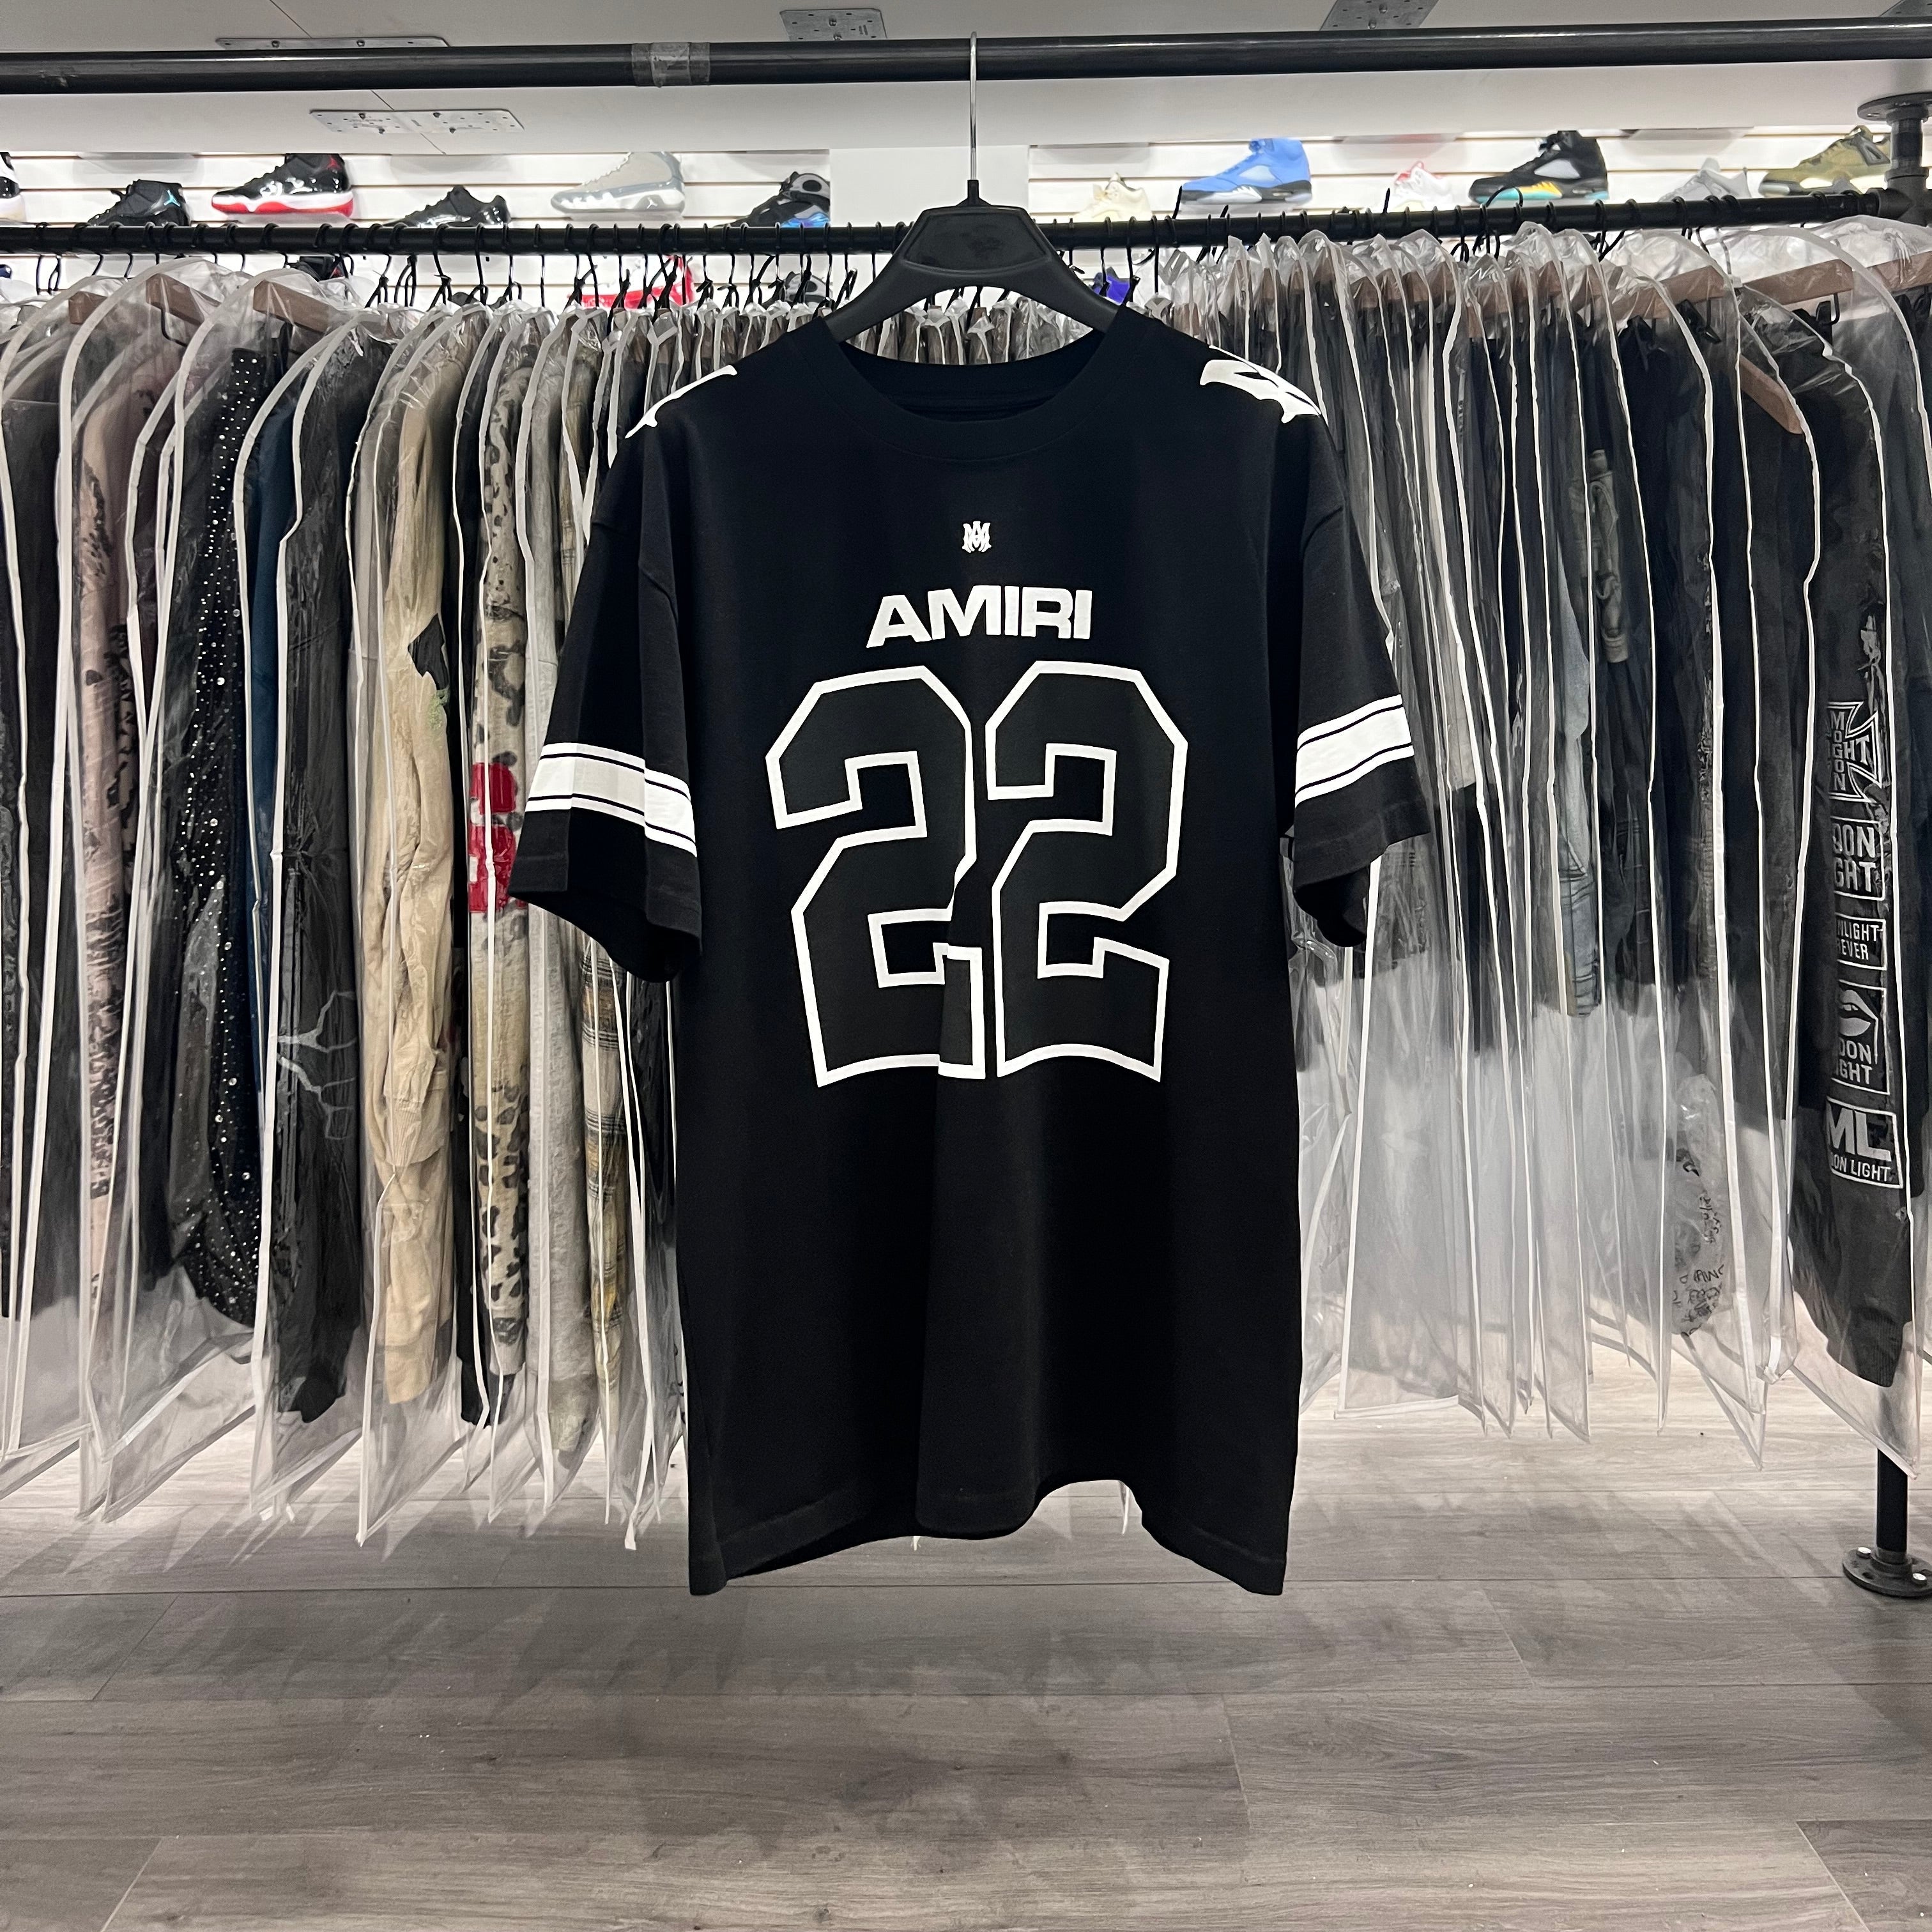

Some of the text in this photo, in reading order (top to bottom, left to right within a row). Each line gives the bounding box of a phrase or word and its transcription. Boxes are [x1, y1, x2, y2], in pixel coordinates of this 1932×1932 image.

[866, 585, 1092, 648] AMIRI
[765, 661, 1188, 1087] 22
[1826, 1100, 1892, 1162] ML
[1850, 1160, 1891, 1182] LIGHT
